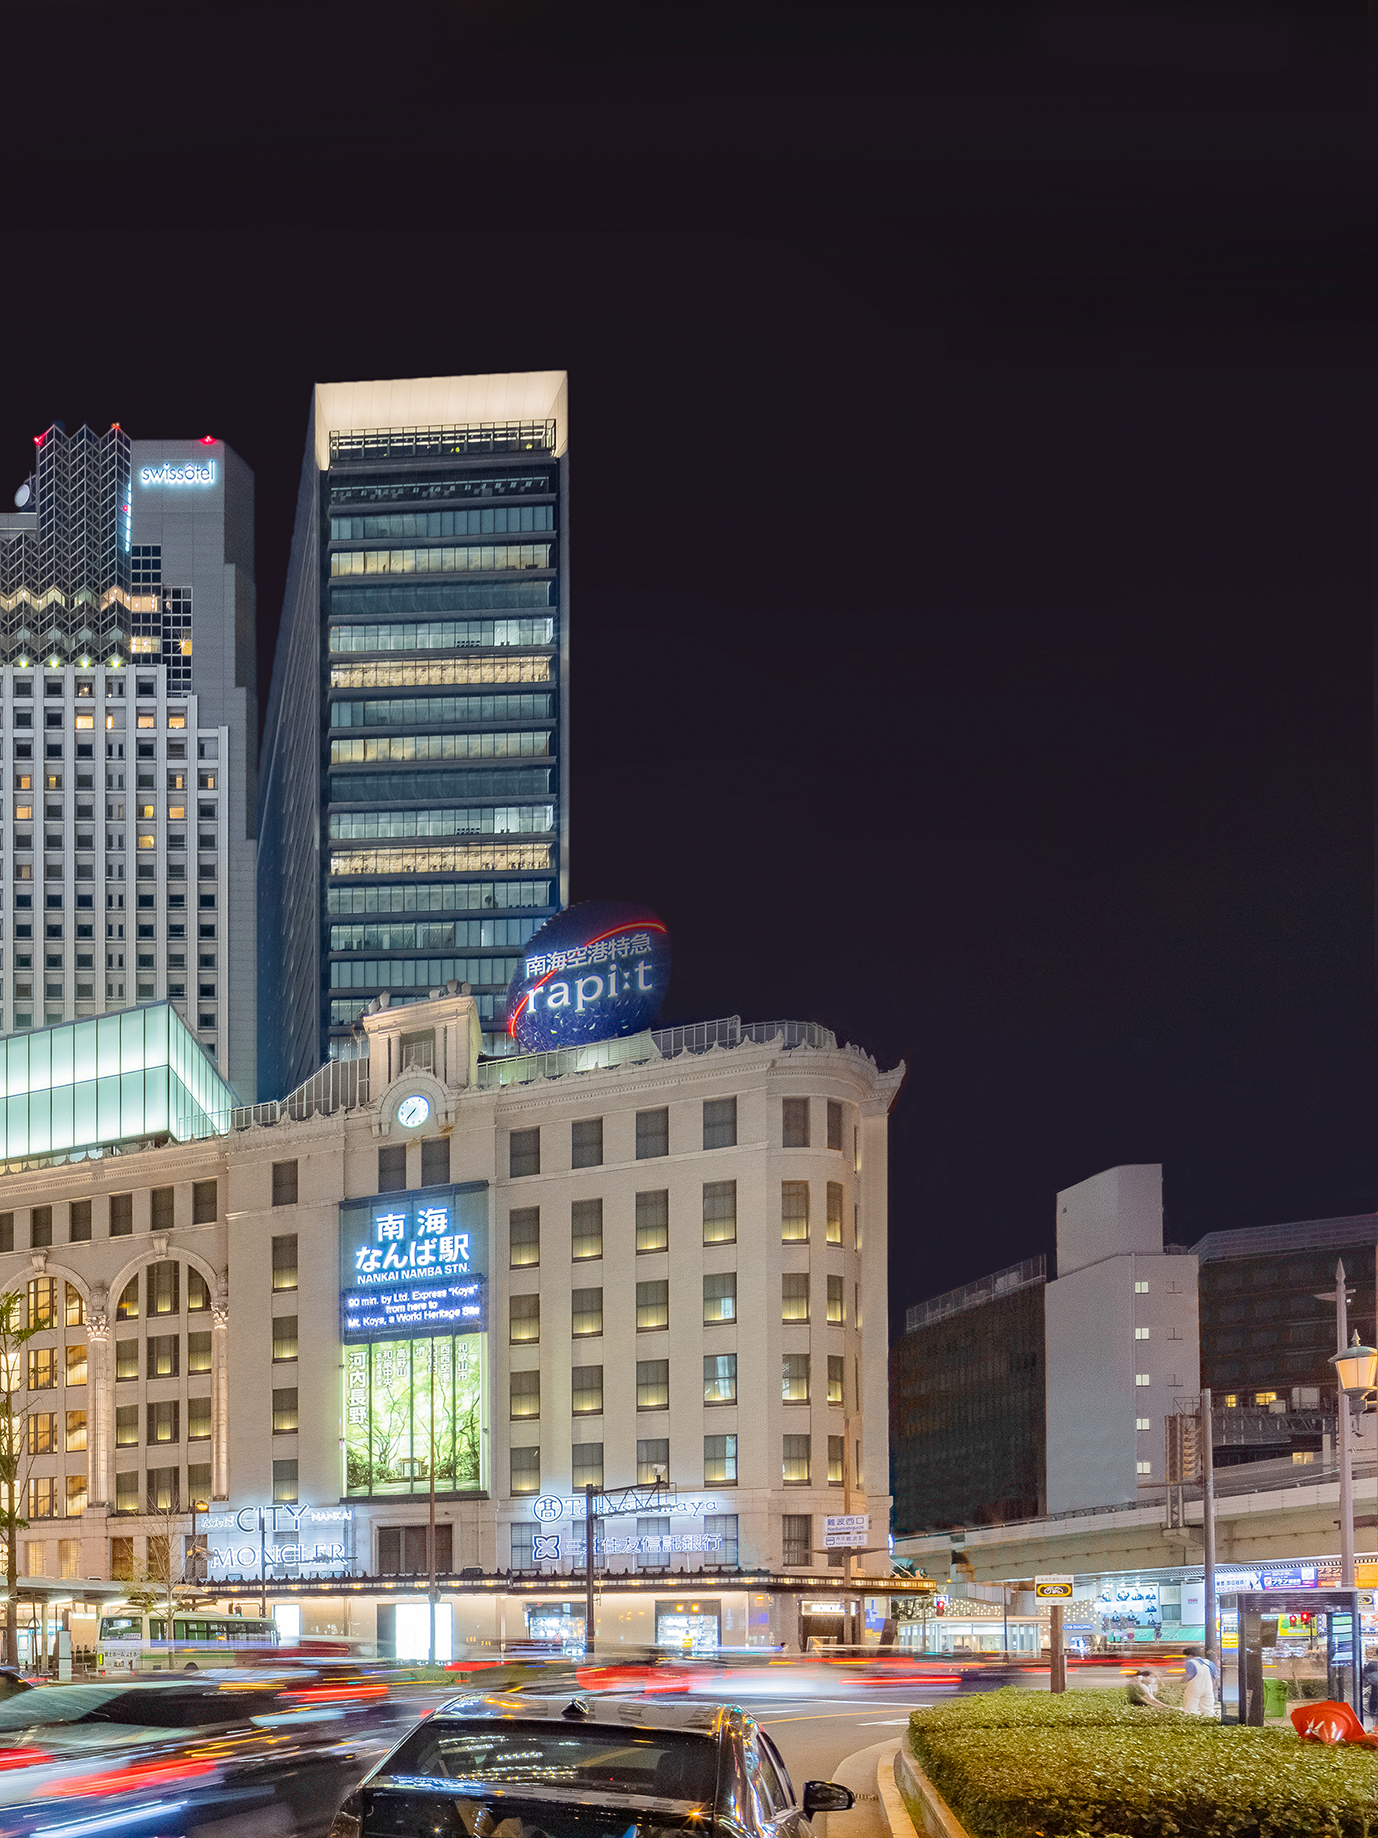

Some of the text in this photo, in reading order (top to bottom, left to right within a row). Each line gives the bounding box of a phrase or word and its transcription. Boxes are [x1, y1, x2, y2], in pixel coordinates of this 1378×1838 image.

[142, 459, 215, 482] swissôtel
[525, 932, 653, 978] 南海空港特急
[355, 1233, 470, 1272] なんば駅
[357, 1262, 471, 1285] NANKAI NAMBA STN.
[348, 1297, 360, 1307] 90
[361, 1296, 379, 1306] min.
[381, 1295, 392, 1305] by
[393, 1293, 410, 1303] Ltd.
[412, 1290, 447, 1301] Express
[385, 1301, 438, 1314] from here to
[348, 1319, 361, 1328] Mt.
[396, 1311, 422, 1323] World
[424, 1308, 461, 1320] Heritage
[462, 1306, 480, 1316] Site
[457, 1342, 469, 1381] 和歌山市
[349, 1351, 367, 1425] 河内長野
[236, 1503, 310, 1533] CITY
[827, 1516, 864, 1526] 難波西口
[211, 1542, 349, 1568] MONCLER
